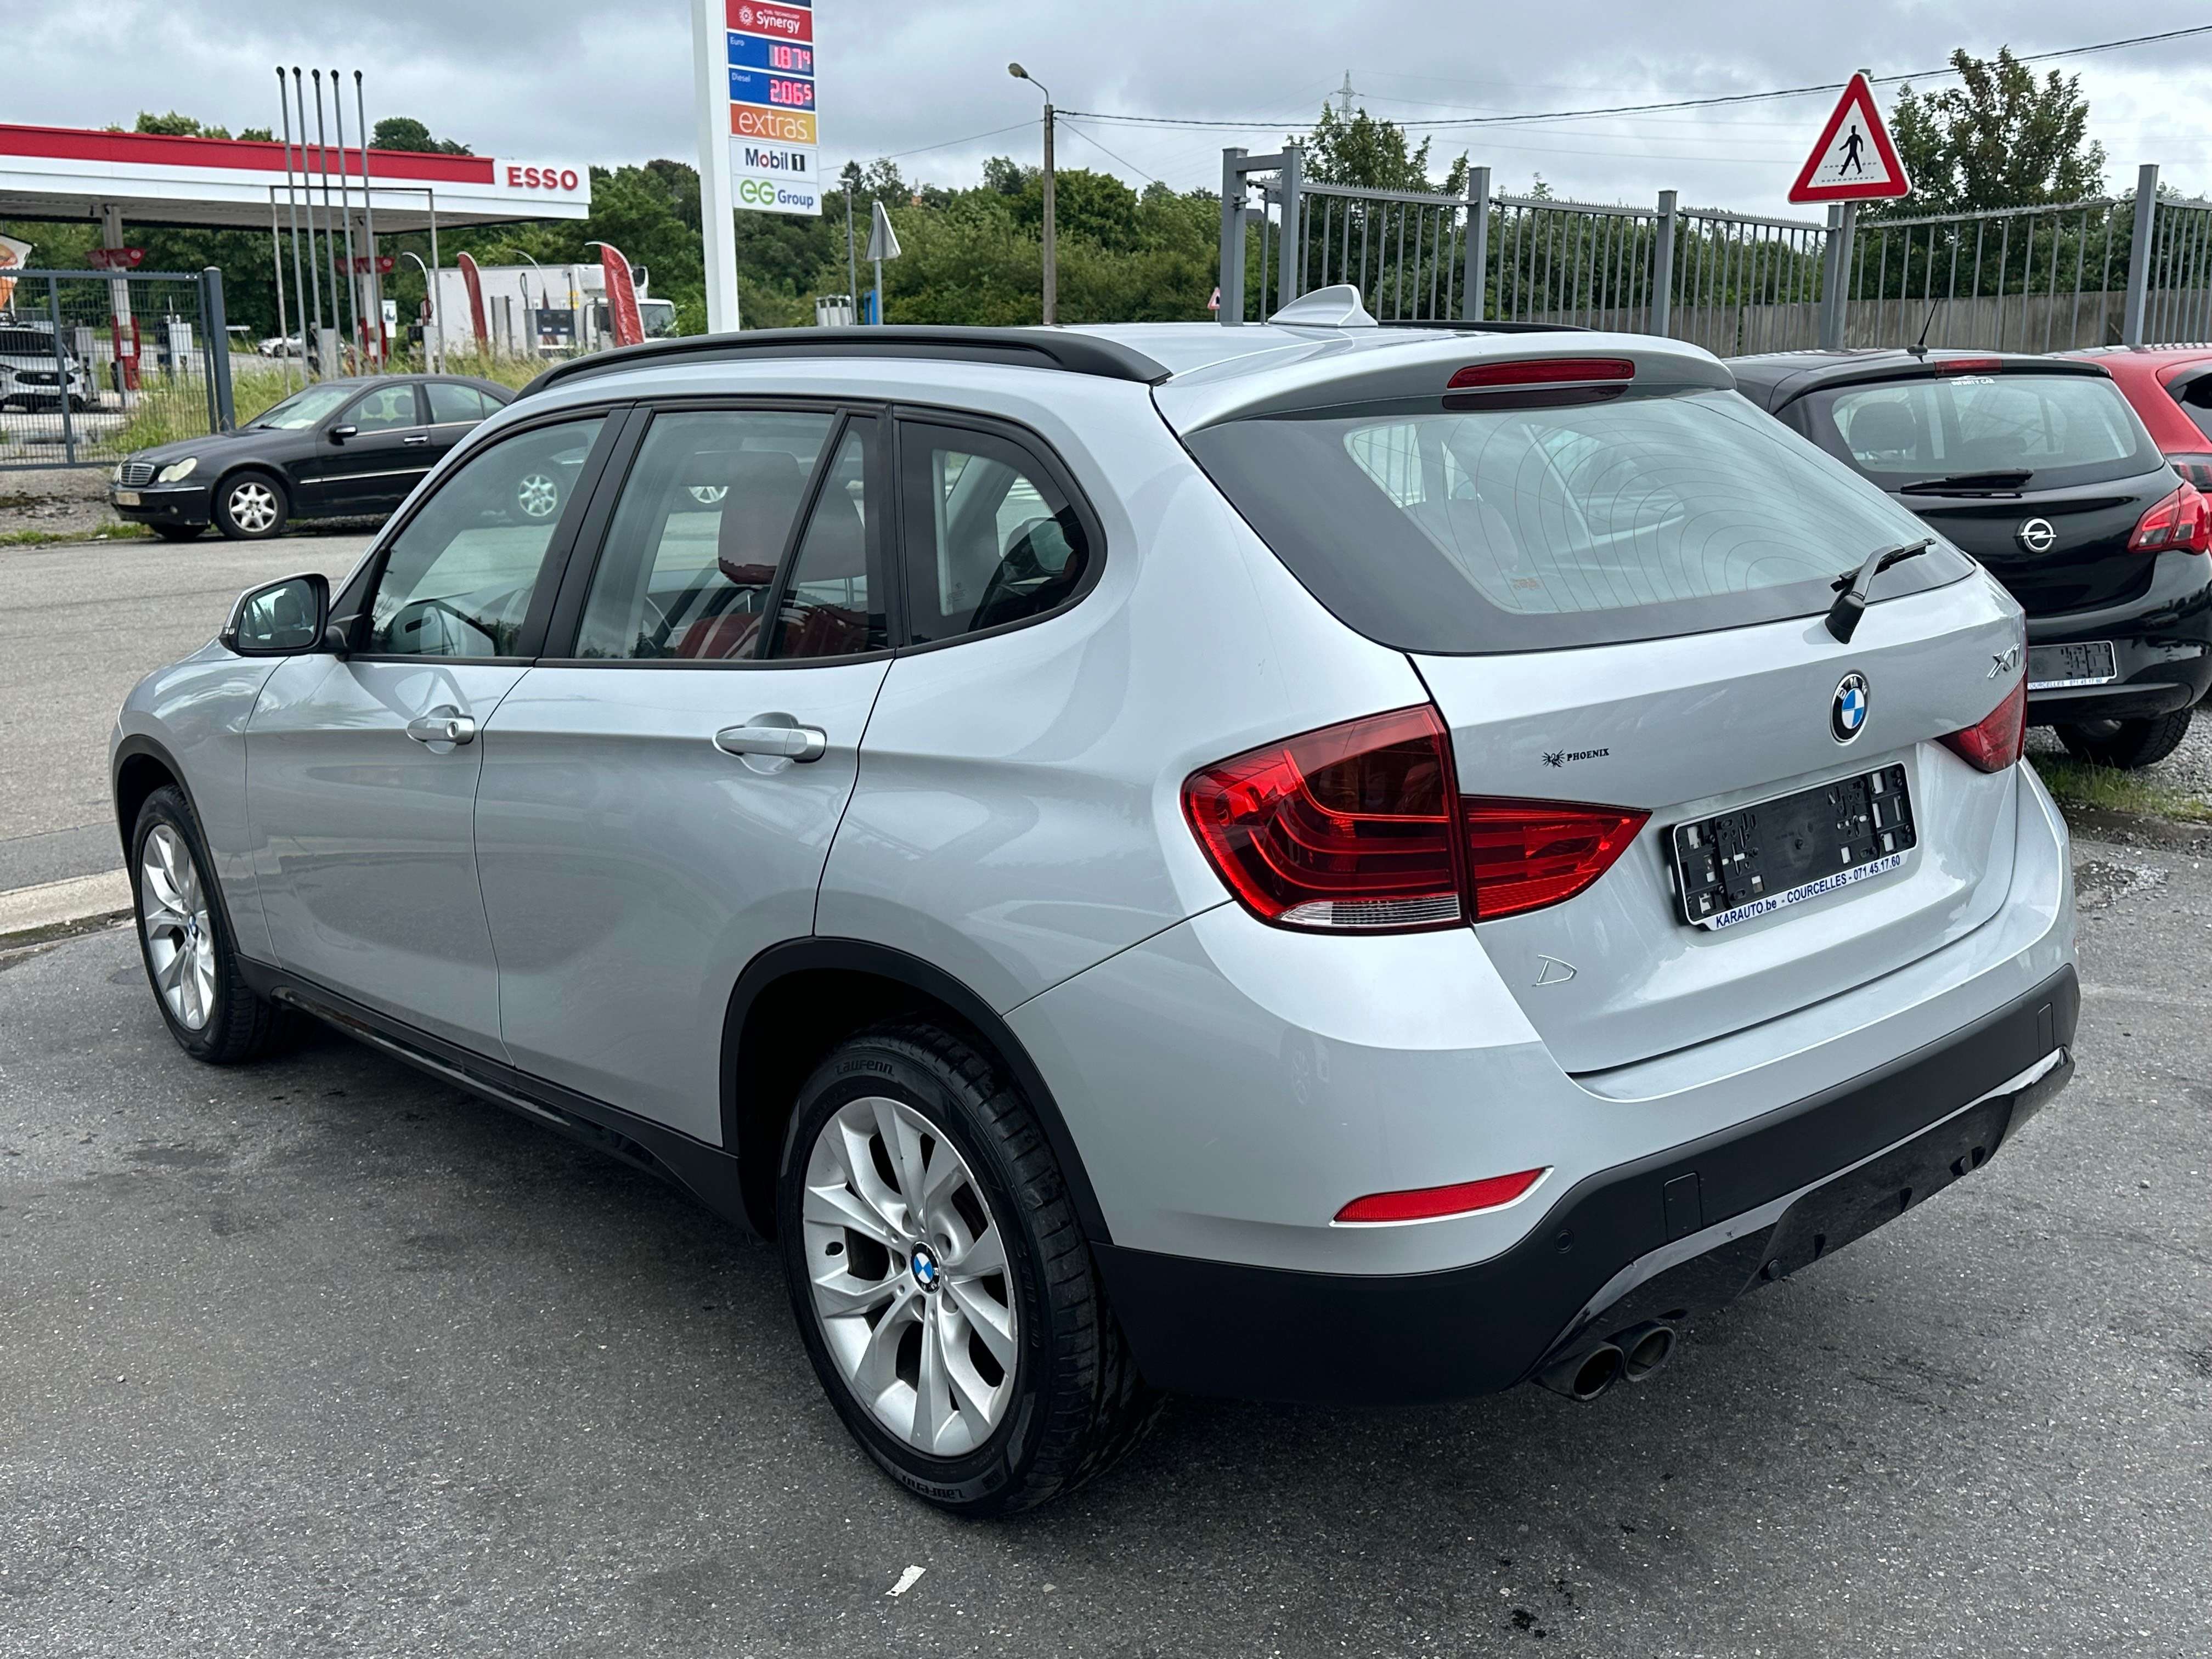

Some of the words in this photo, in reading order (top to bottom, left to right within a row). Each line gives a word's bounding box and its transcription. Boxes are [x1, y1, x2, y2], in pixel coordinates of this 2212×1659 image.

[757, 11, 800, 34] Synergy
[730, 37, 744, 46] Euro
[731, 72, 751, 82] Diesel
[739, 110, 808, 140] extras
[745, 148, 788, 170] Mobil
[507, 166, 578, 191] ESSO
[777, 189, 814, 210] Group
[1567, 748, 1610, 761] PHOENIX
[1716, 899, 1777, 928] KARAUTO.be
[1787, 873, 1847, 904] COURCELLES
[1853, 854, 1900, 881] 071.45.17.60
